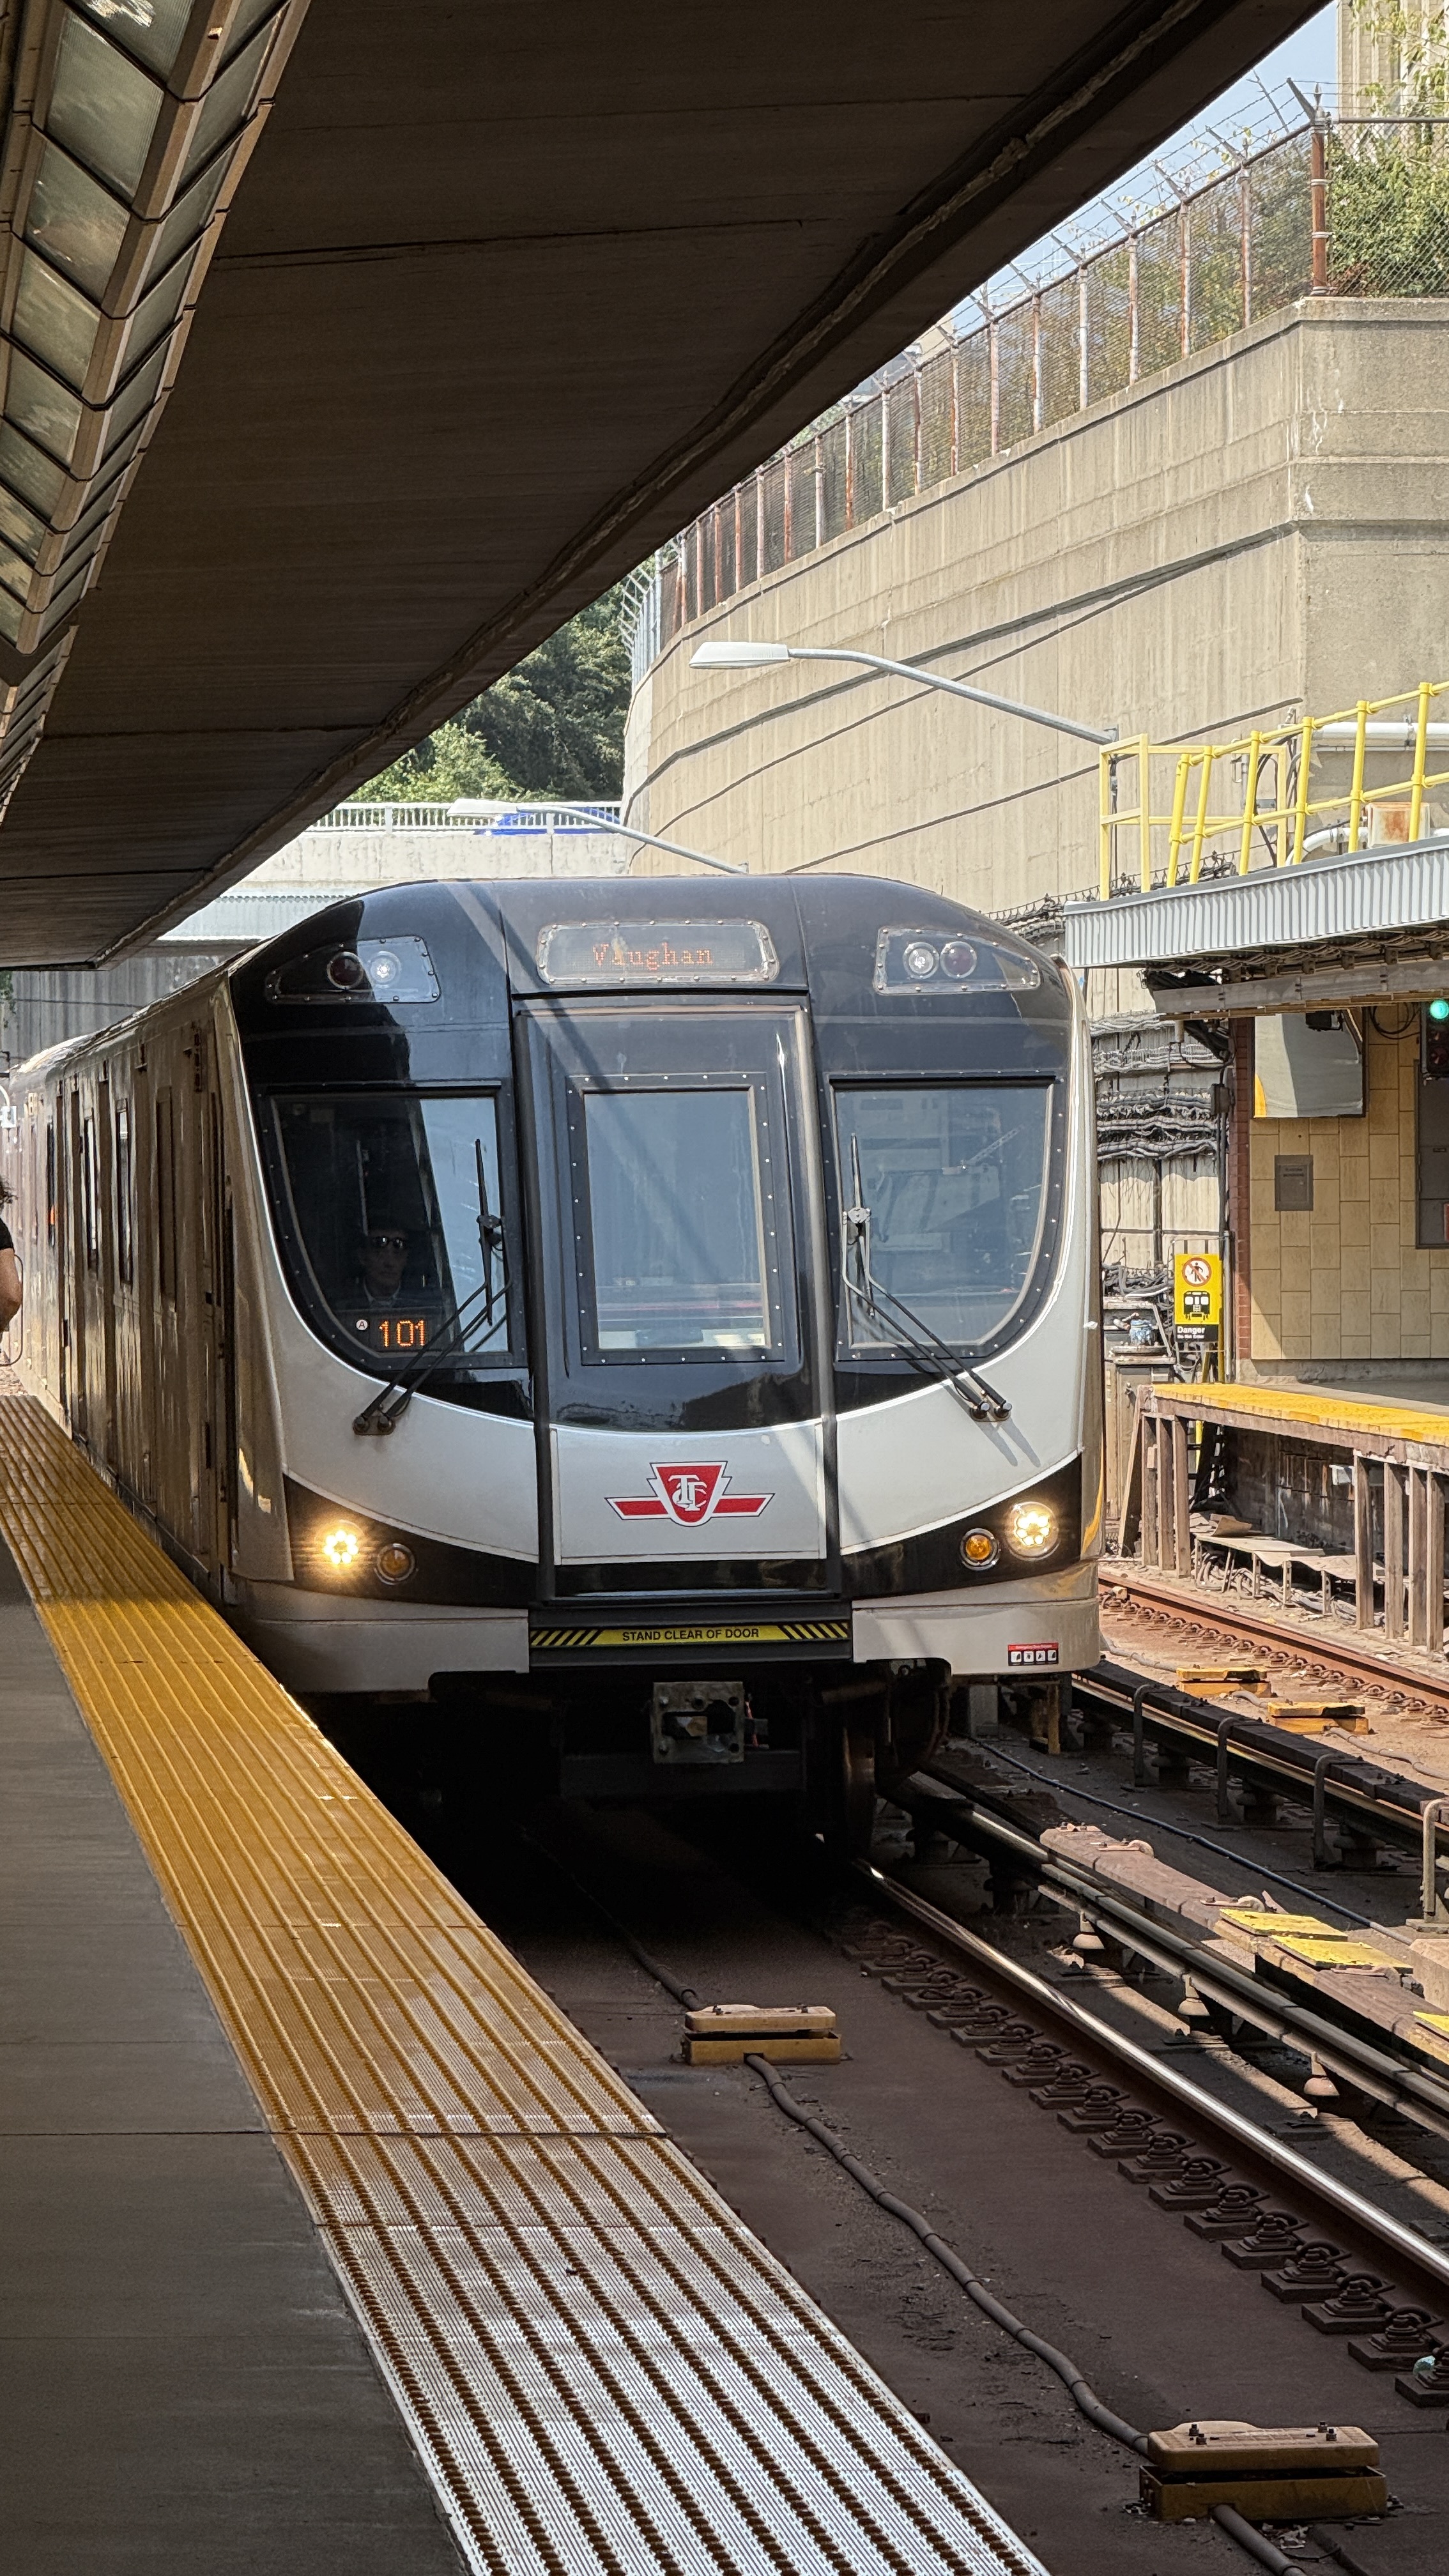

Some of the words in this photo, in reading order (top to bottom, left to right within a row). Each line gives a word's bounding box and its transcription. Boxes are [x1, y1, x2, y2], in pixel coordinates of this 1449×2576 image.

[593, 942, 713, 970] Vaughan
[379, 1320, 425, 1347] 101
[1177, 1326, 1205, 1334] Danger
[622, 1630, 661, 1641] STAND
[664, 1630, 703, 1640] CLEAR
[706, 1629, 723, 1639] OF
[724, 1628, 760, 1638] DOOR
